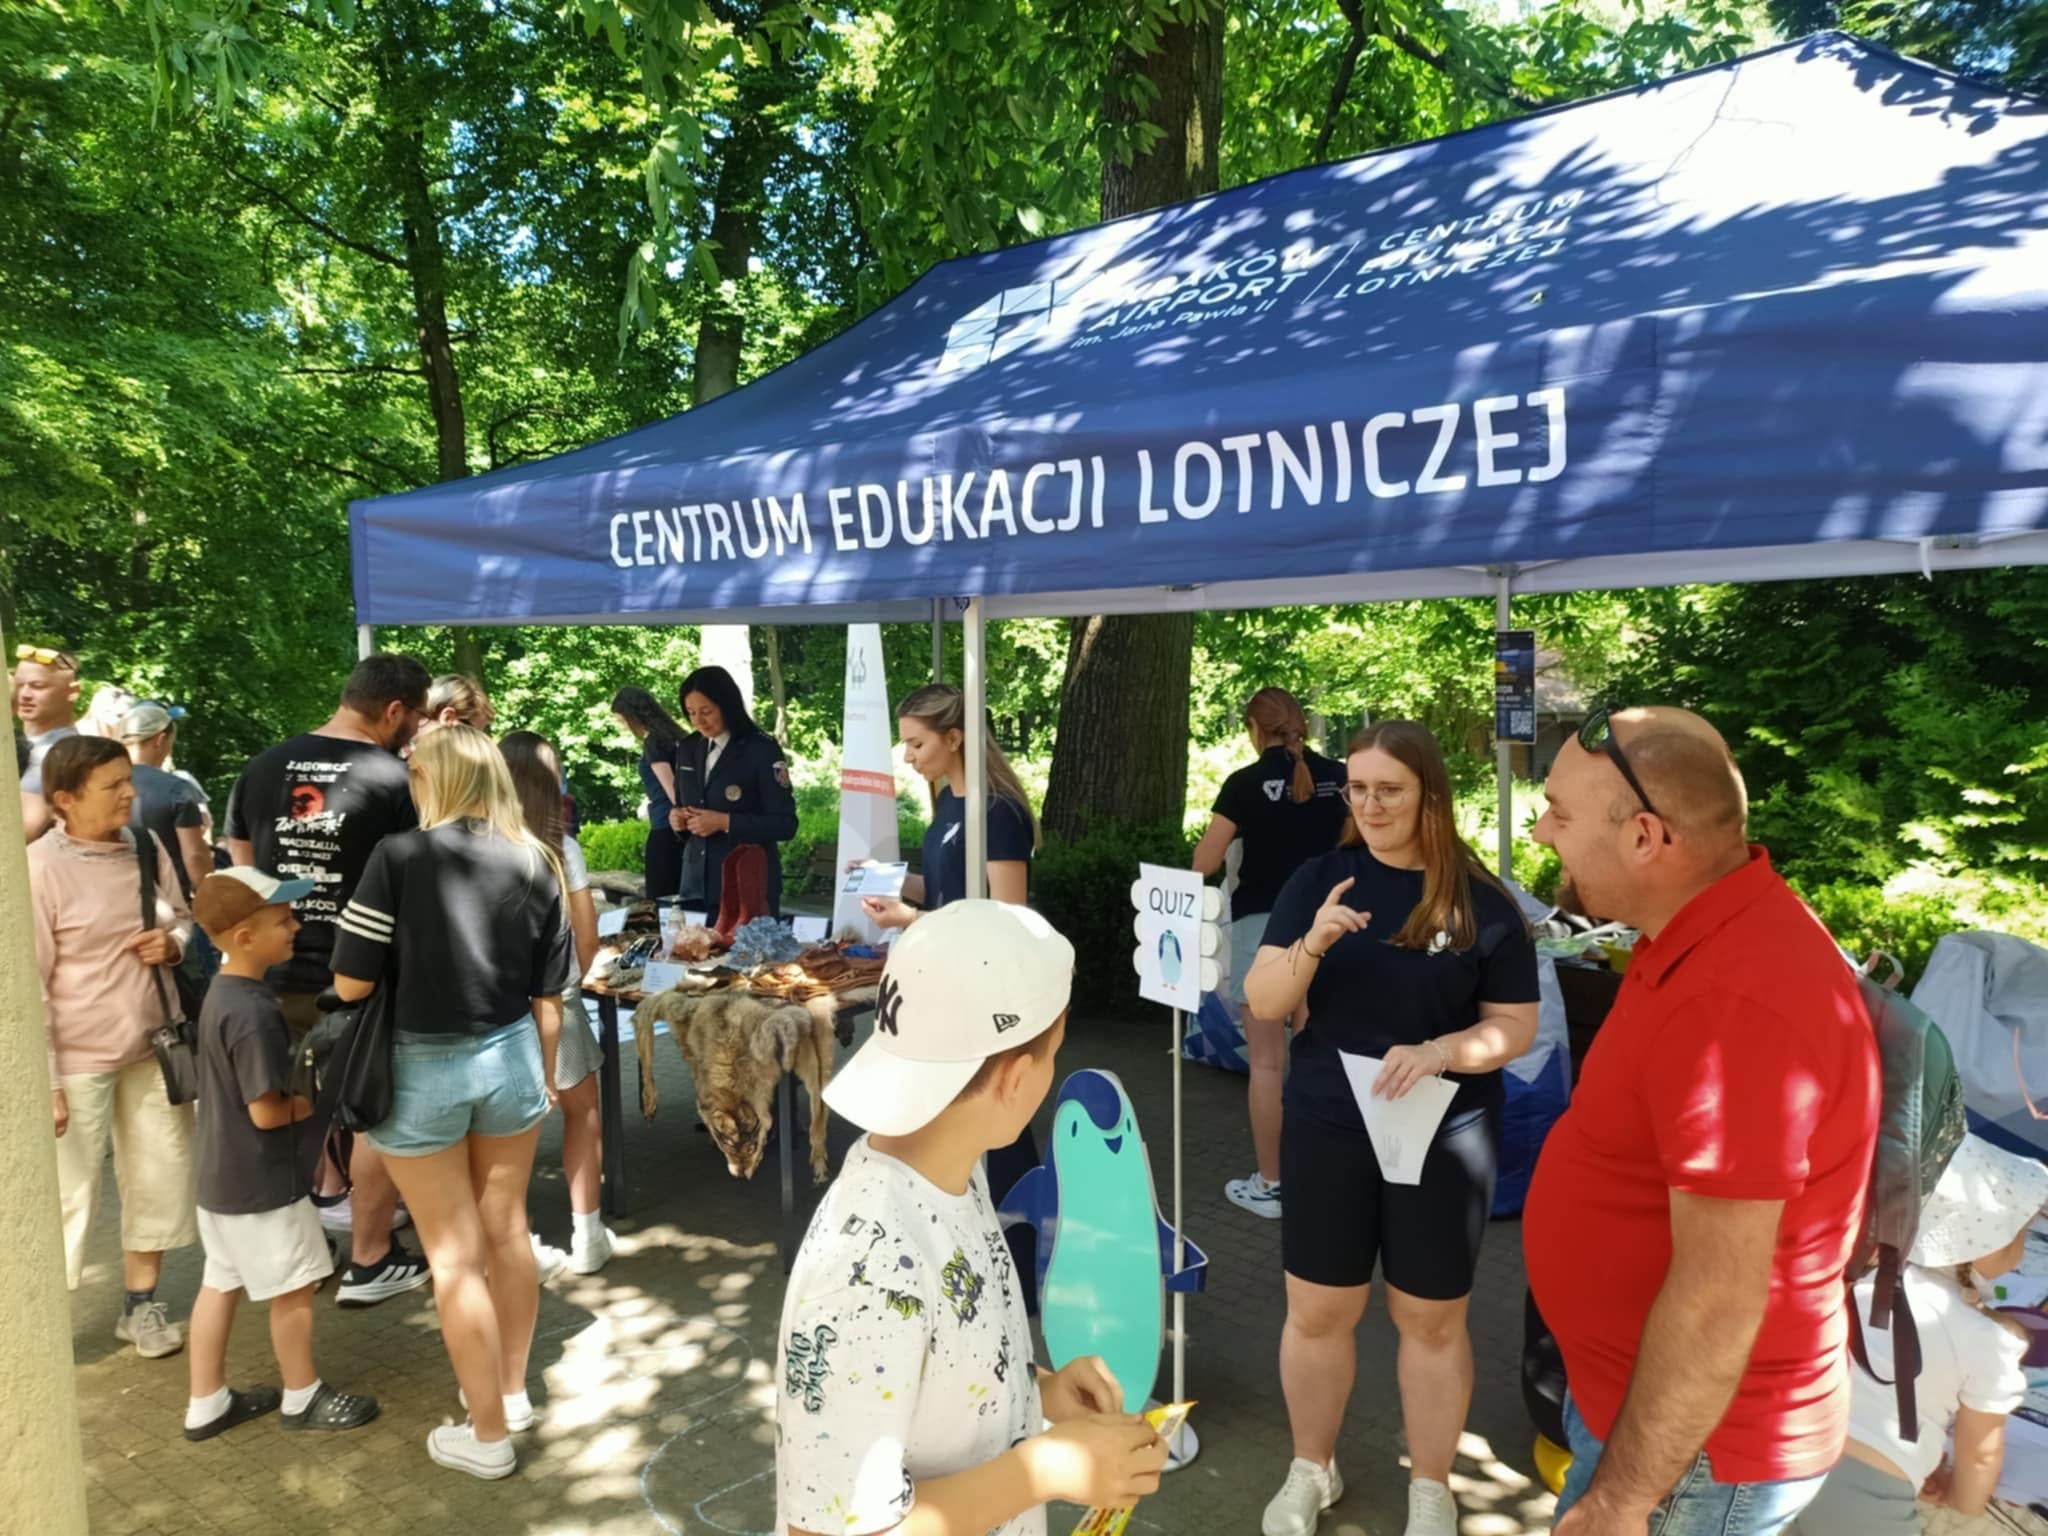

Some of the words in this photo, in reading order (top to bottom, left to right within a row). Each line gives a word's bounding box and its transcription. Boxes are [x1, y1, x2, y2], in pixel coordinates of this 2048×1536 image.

[1379, 189, 1585, 250] CENTRUM
[1114, 247, 1332, 306] AKÓW
[1333, 238, 1567, 300] LOTNICZEJ
[1087, 271, 1308, 332] AIRPORT
[1109, 319, 1165, 341] Jana
[609, 492, 813, 568] CENTRUM
[828, 455, 1106, 552] EDUKACJI
[1137, 387, 1568, 524] LOTNICZEJ
[1149, 886, 1196, 919] QUIZ
